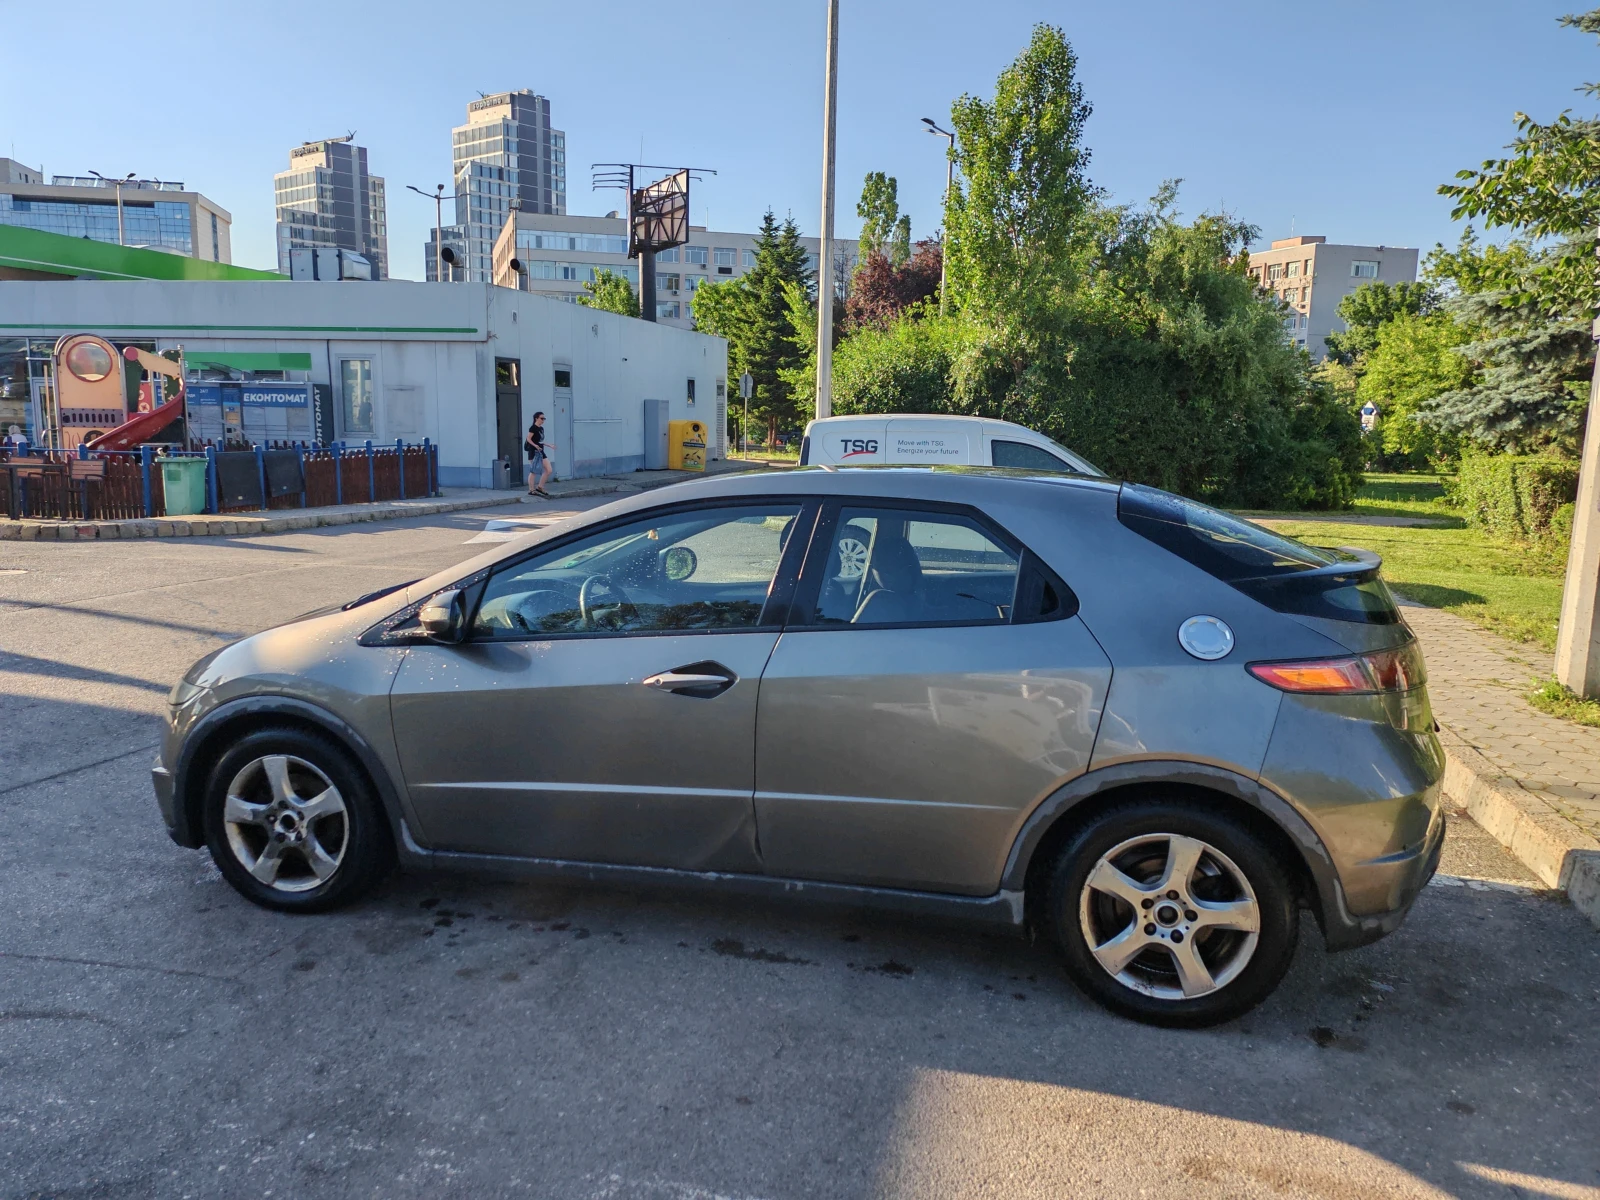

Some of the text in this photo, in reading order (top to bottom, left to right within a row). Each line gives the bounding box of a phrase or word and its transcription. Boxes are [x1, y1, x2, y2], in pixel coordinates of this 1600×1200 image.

[243, 393, 307, 403] ЕКОНТОМАТ
[314, 386, 323, 447] ОНТОМАТ
[840, 439, 878, 453] TSG
[897, 447, 924, 455] Energize
